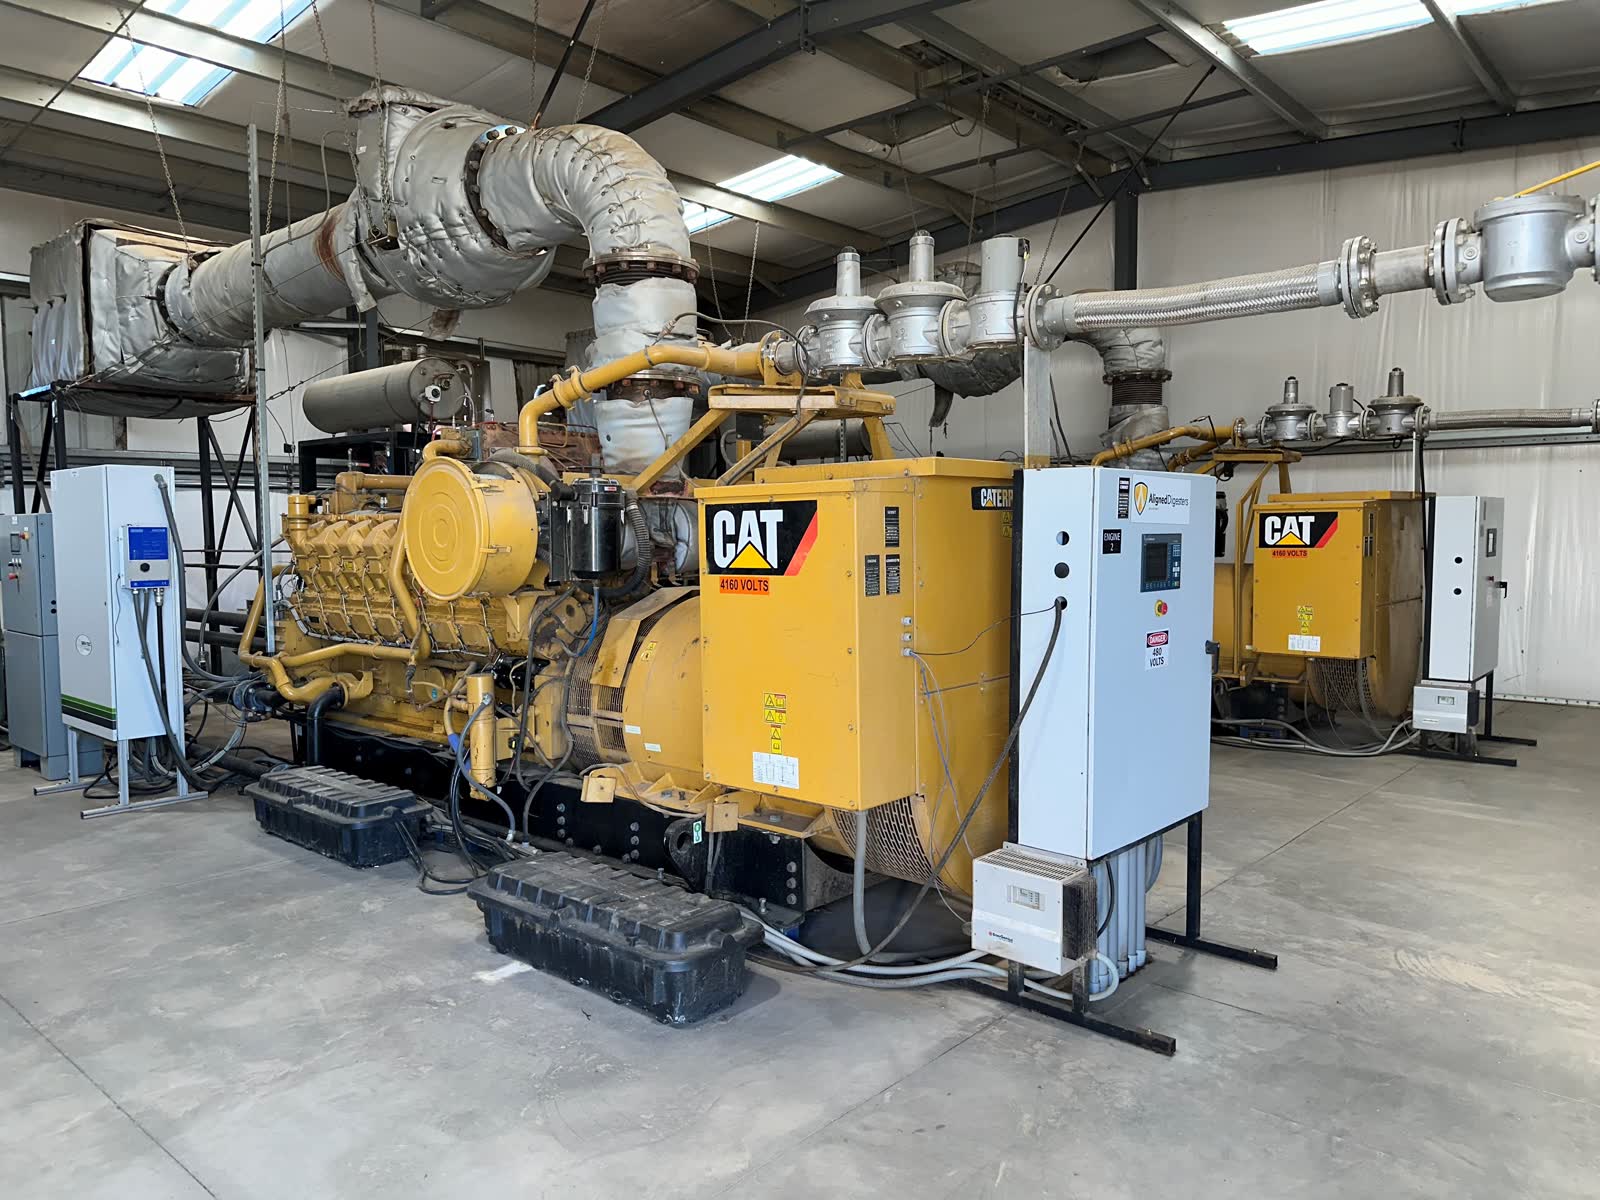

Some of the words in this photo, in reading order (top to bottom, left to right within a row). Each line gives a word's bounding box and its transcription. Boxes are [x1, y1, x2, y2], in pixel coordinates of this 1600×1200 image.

[1148, 492, 1189, 507] AlignedDigesters
[1264, 515, 1315, 545] CAT
[713, 509, 783, 569] CAT
[1103, 532, 1121, 541] ENGINE
[720, 579, 739, 591] 4160
[741, 579, 769, 592] VOLTS
[1149, 634, 1167, 644] DANGER
[1152, 647, 1162, 656] 480
[1149, 656, 1164, 667] VOLTS
